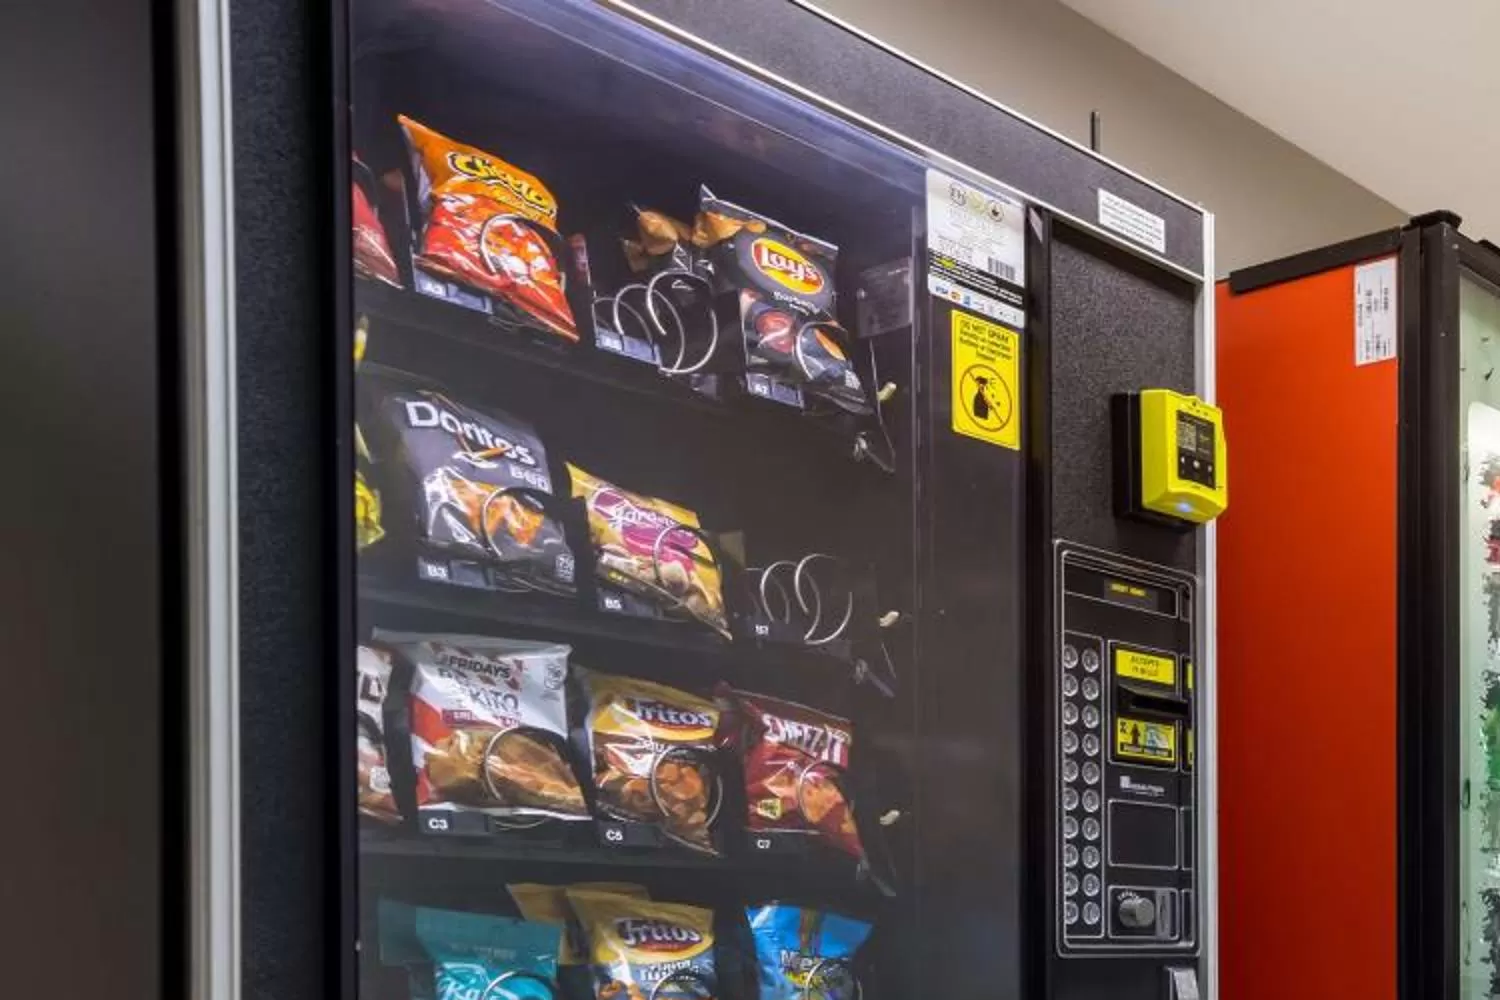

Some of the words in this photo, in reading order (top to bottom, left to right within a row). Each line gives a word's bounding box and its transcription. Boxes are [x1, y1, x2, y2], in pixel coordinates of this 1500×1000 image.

[760, 246, 817, 281] Lay's
[406, 401, 536, 465] Doritos
[428, 817, 448, 830] C3
